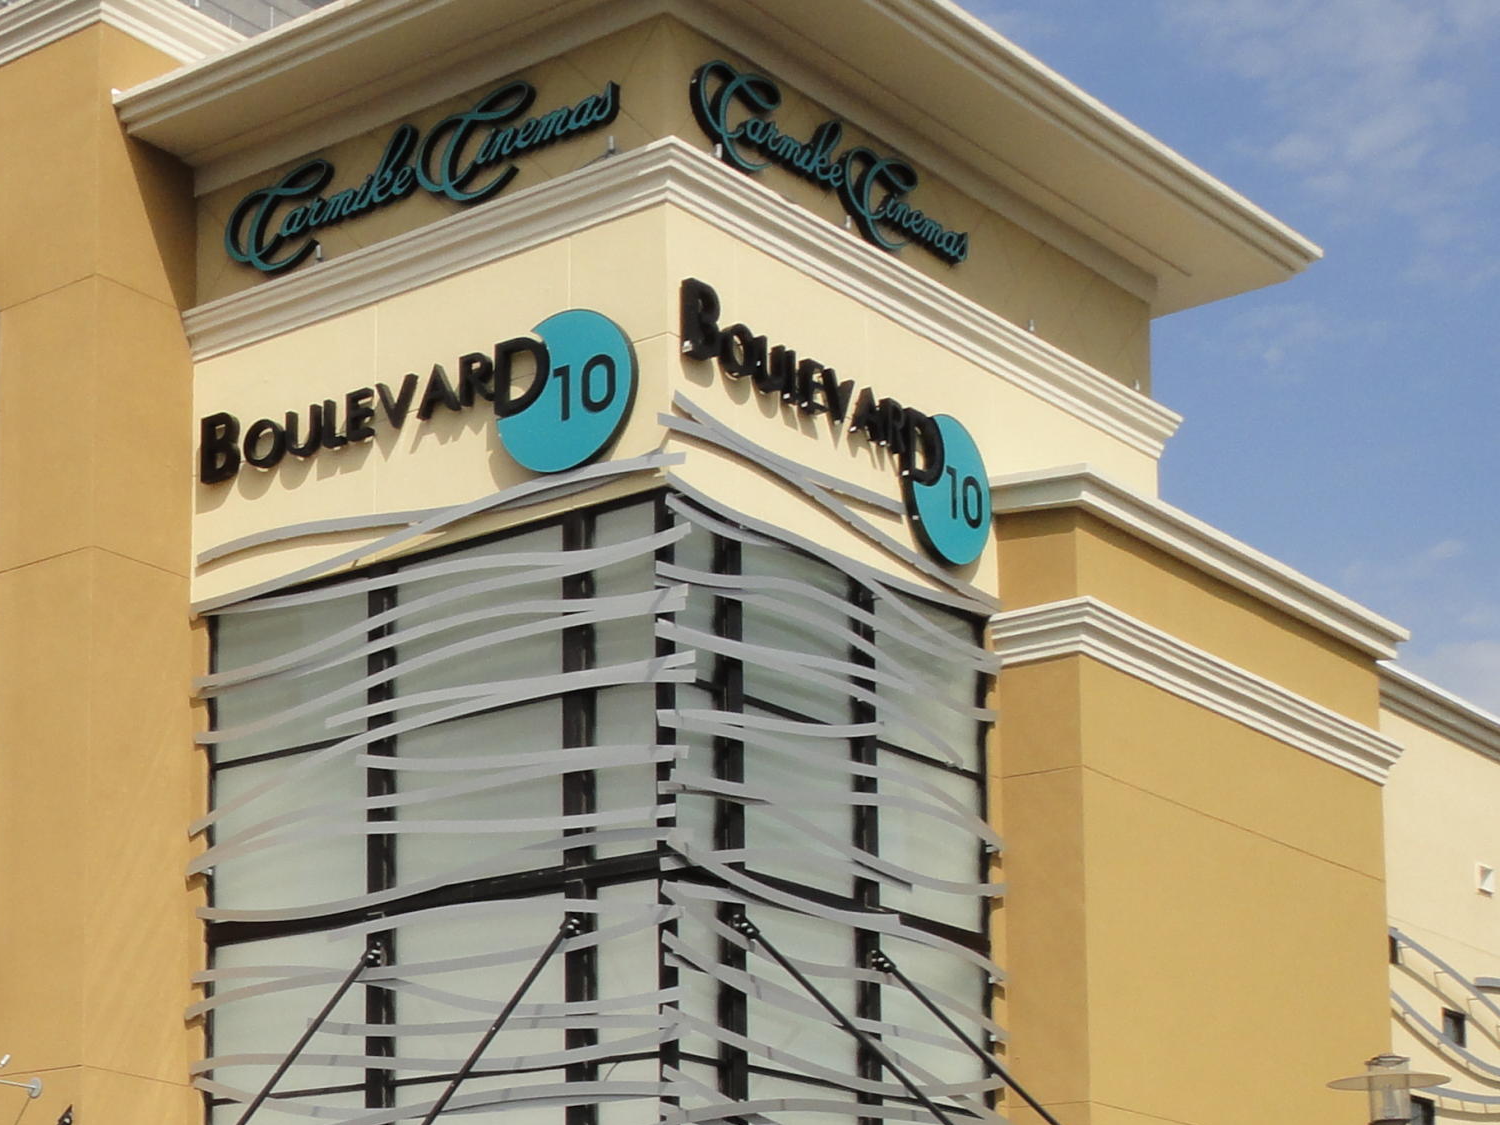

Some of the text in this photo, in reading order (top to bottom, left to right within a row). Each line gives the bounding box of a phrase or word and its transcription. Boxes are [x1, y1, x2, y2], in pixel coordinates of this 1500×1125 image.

[224, 79, 620, 274] Carmike Cinemas
[690, 59, 970, 266] Carmike Cinemas
[199, 334, 618, 485] BOULEVARD 10
[680, 277, 985, 531] BOULEVARD 10
